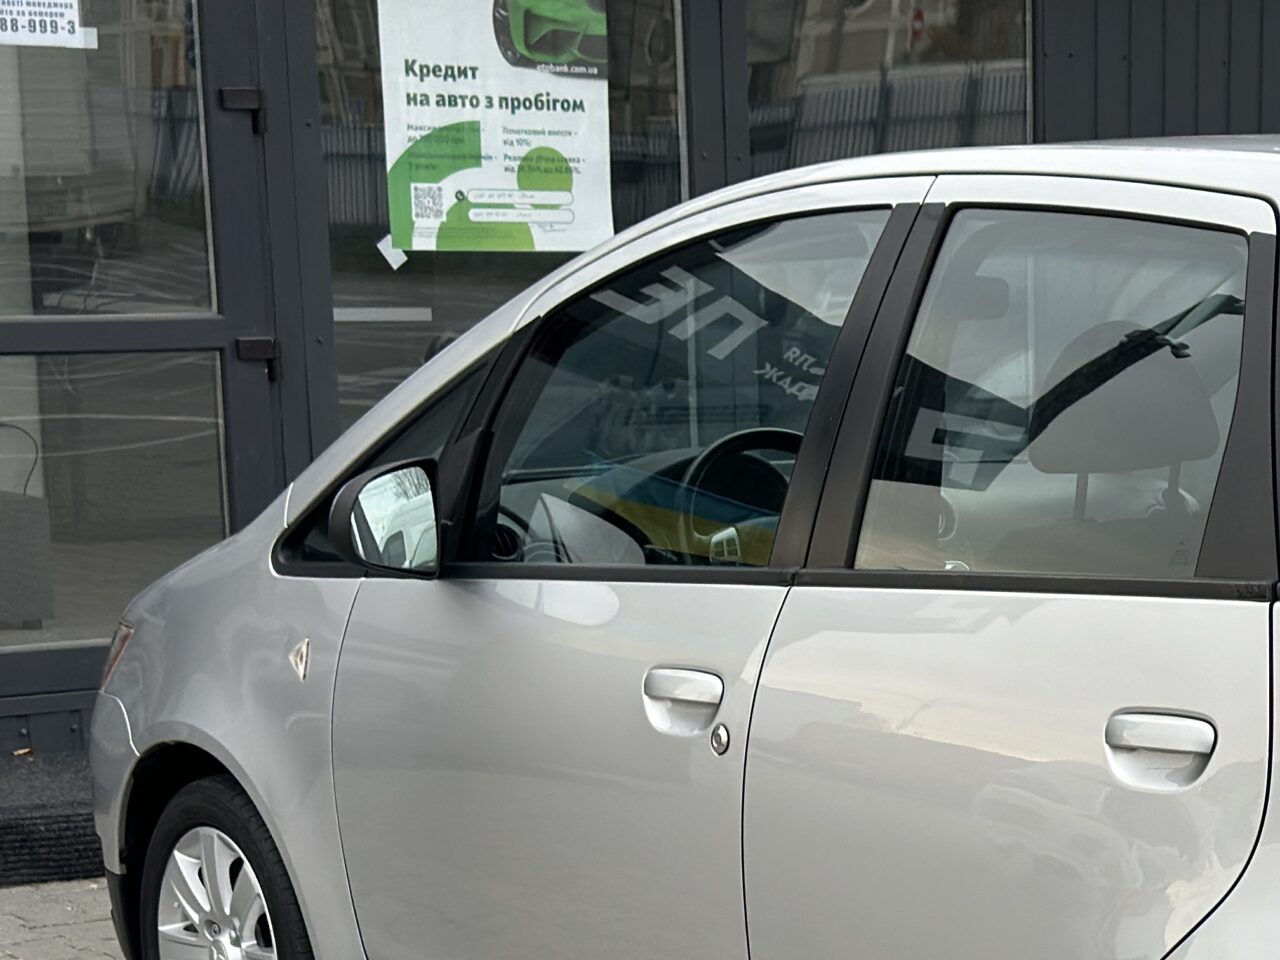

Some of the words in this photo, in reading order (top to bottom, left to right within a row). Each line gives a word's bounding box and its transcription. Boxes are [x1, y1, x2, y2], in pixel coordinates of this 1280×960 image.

[404, 59, 479, 82] Кредит
[406, 92, 430, 108] на
[435, 93, 480, 110] авто
[485, 95, 494, 110] з
[499, 92, 586, 114] пробігом
